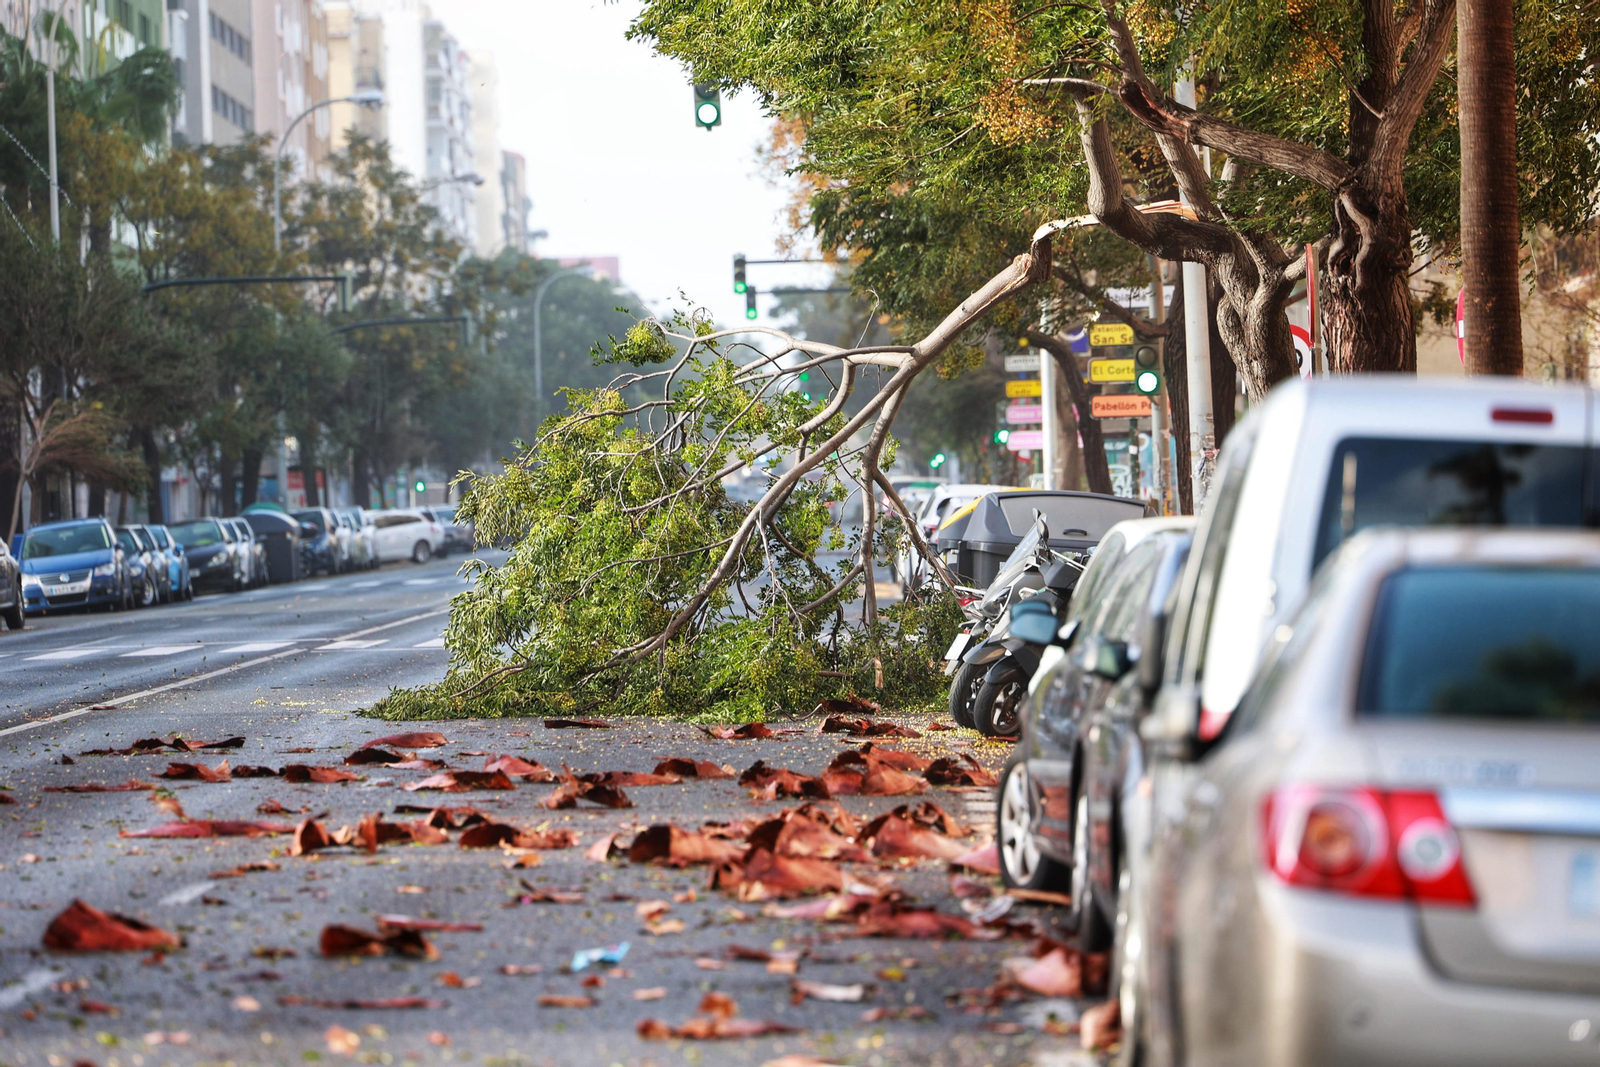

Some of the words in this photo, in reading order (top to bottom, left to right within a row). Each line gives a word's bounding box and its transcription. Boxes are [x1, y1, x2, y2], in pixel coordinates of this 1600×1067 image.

[1093, 334, 1115, 344] San
[1092, 366, 1103, 375] El
[1094, 401, 1137, 410] Pabellón
